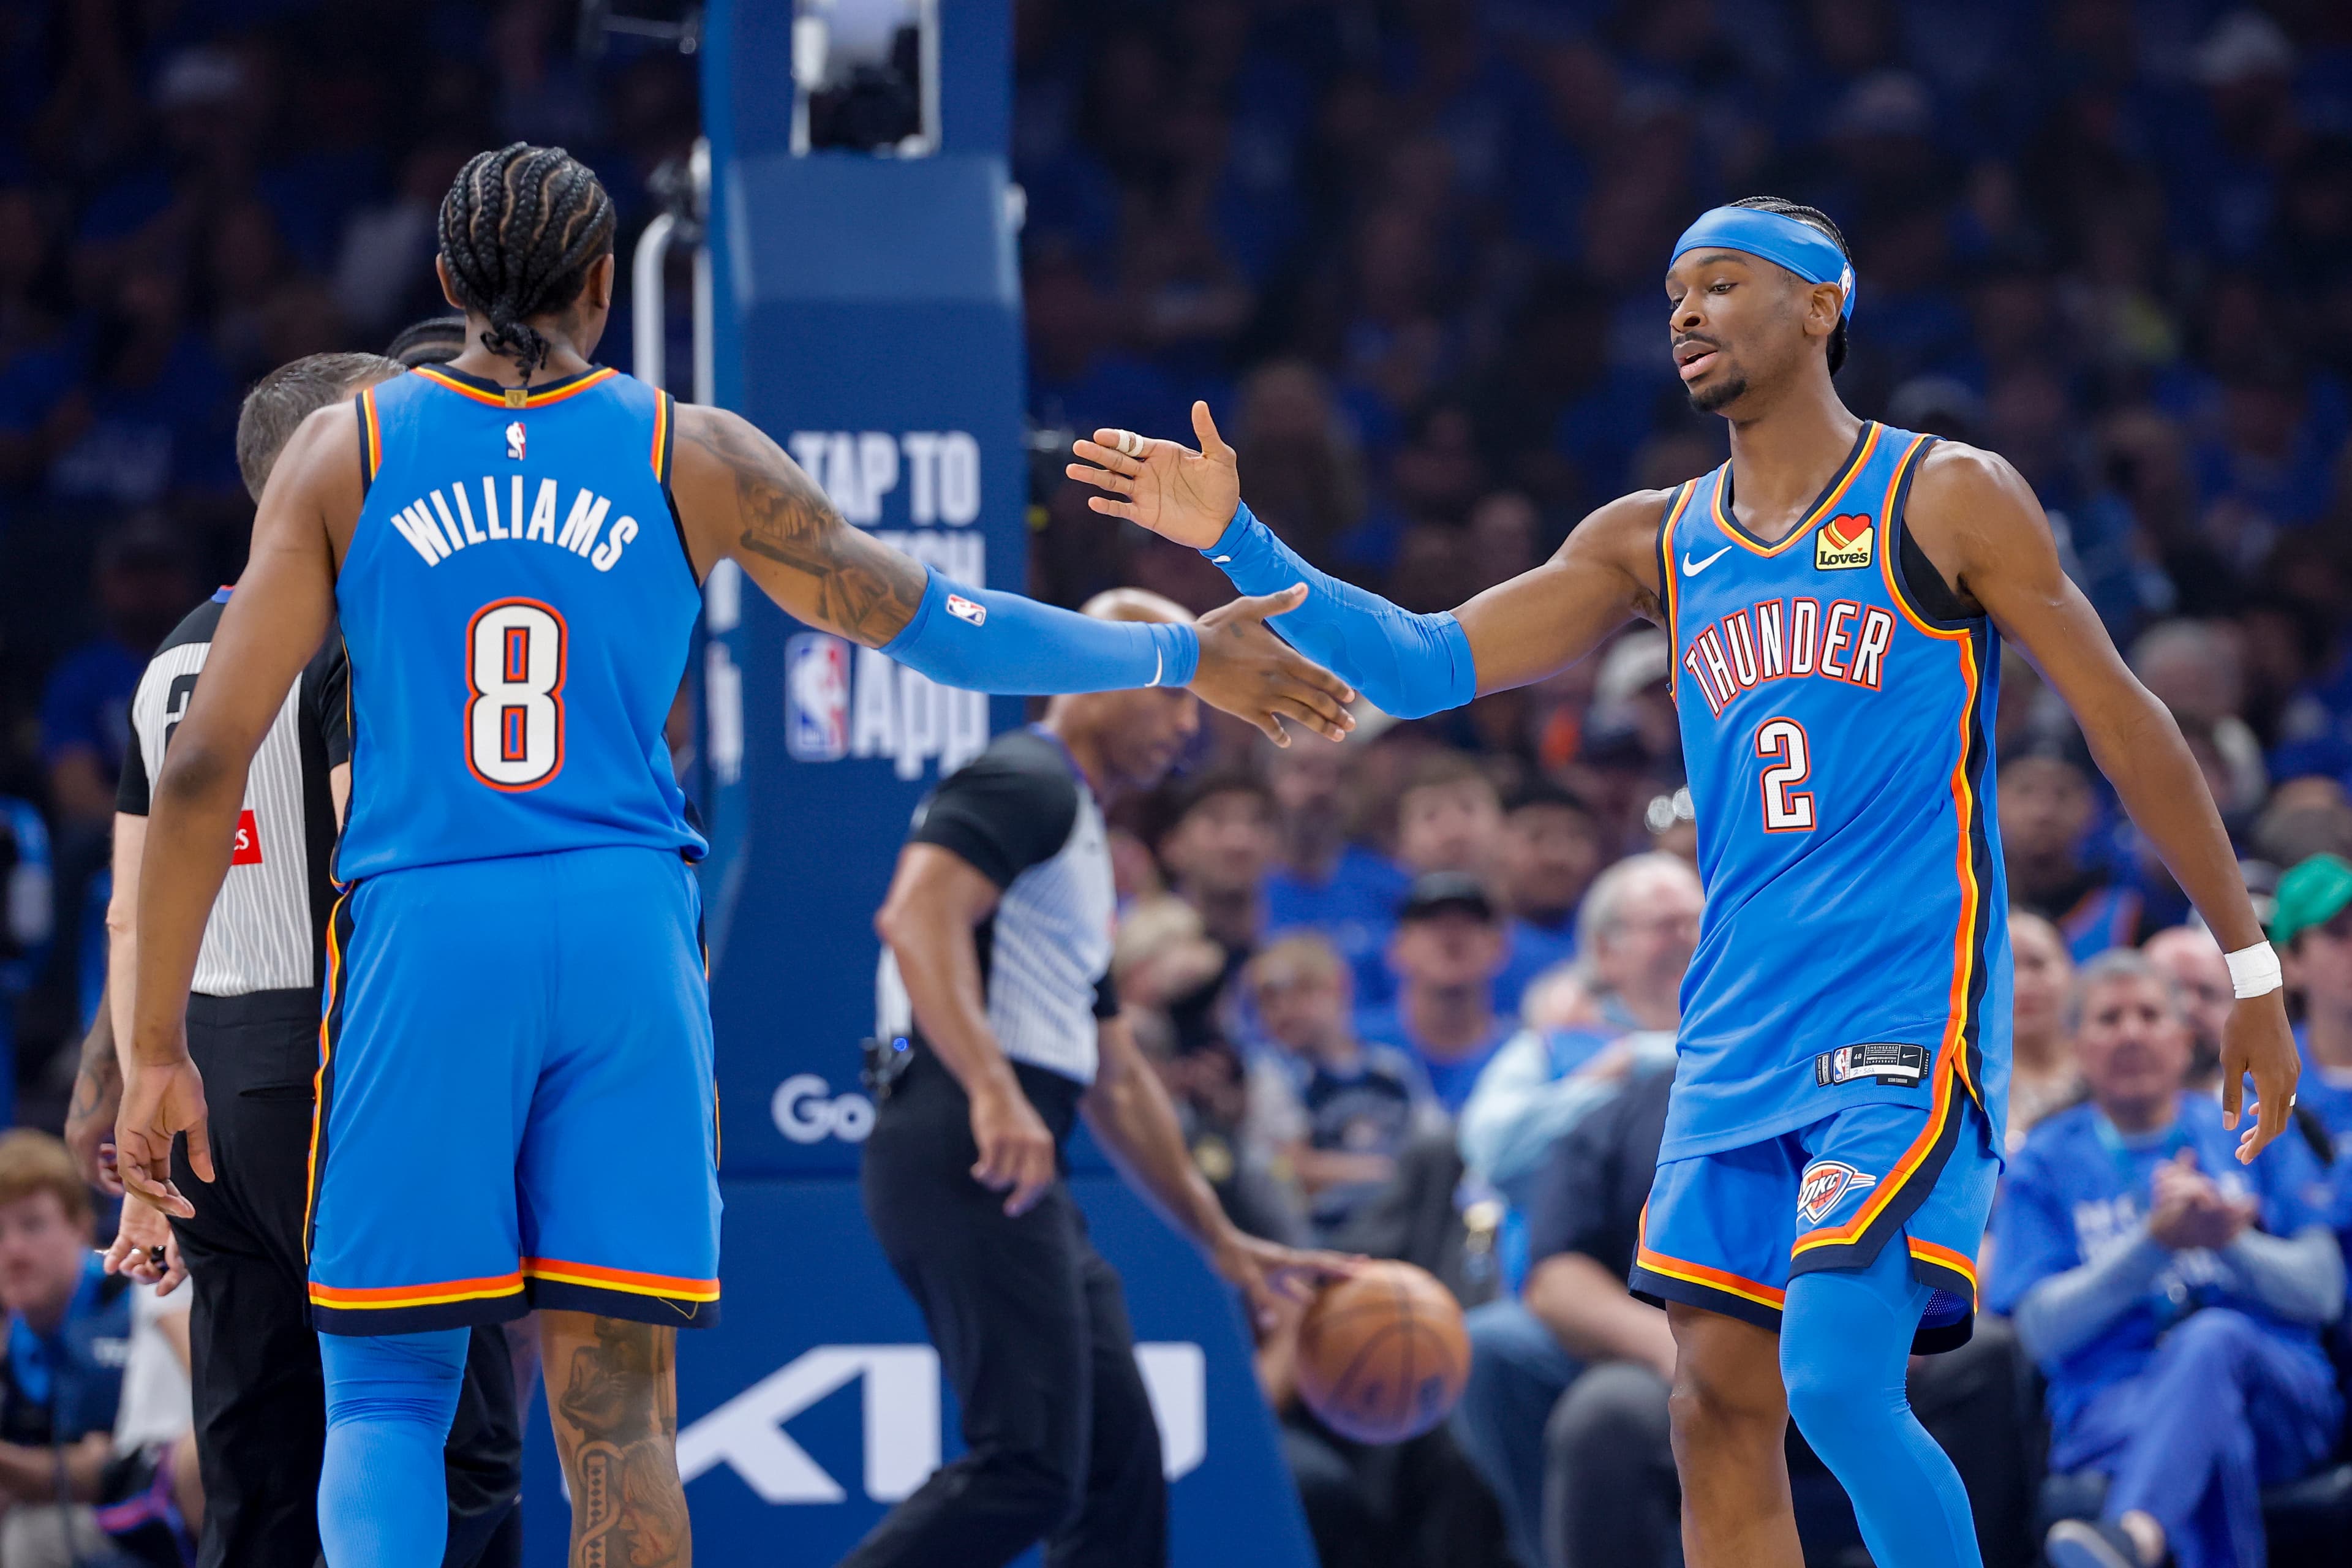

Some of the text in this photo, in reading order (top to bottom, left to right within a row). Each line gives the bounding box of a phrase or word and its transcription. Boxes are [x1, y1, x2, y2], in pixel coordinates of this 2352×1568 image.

[391, 475, 638, 572] WILLIAMS
[789, 430, 980, 527] TAP TO
[465, 597, 568, 793] 8
[1683, 597, 1897, 719] THUNDER
[1755, 717, 1817, 834] 2
[1797, 1172, 1841, 1213] OKC
